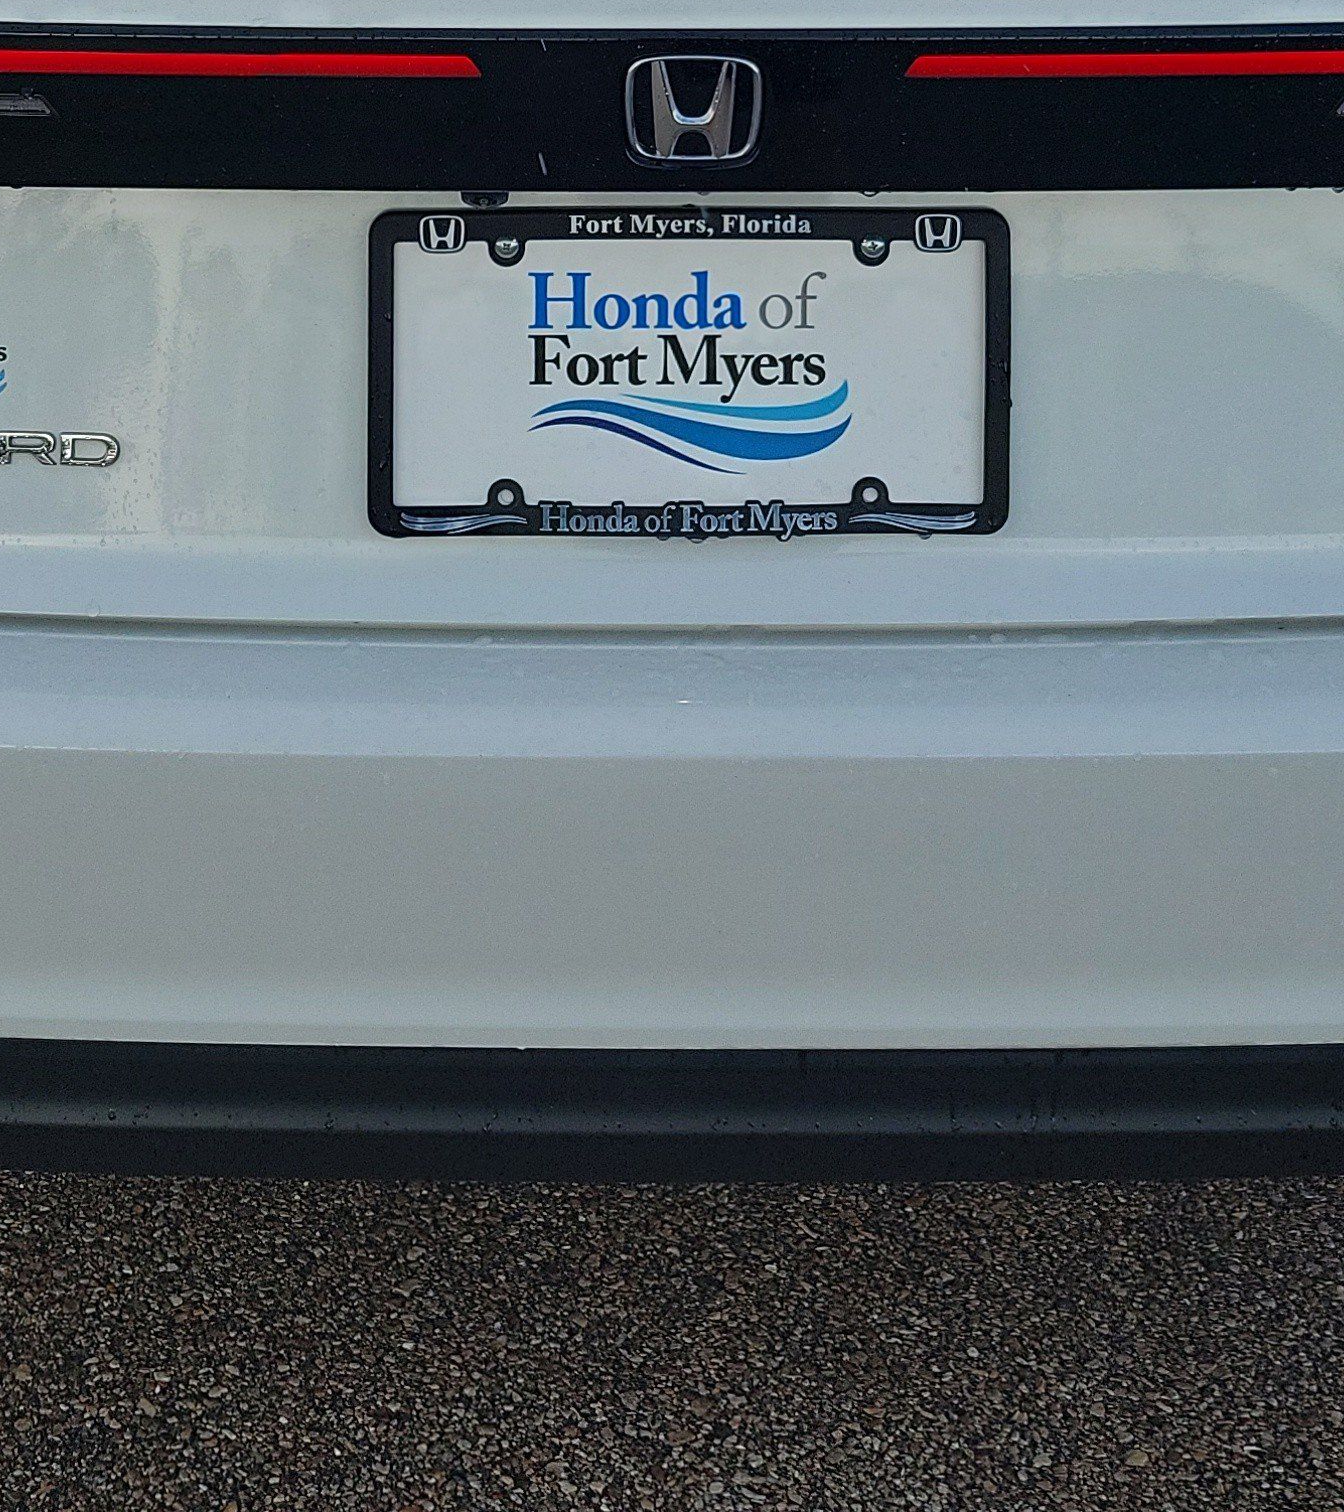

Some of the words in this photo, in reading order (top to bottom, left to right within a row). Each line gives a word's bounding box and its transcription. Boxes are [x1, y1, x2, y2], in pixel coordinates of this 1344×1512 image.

[569, 215, 623, 234] Fort
[630, 215, 713, 238] Myers,
[721, 214, 812, 234] Florida
[528, 270, 747, 330] Honda
[759, 271, 827, 330] of
[528, 334, 648, 386] Fort
[656, 334, 826, 404] Myers
[540, 504, 640, 532] Honda
[644, 504, 676, 532] of
[680, 504, 744, 532] Fort
[747, 503, 838, 540] Myers
